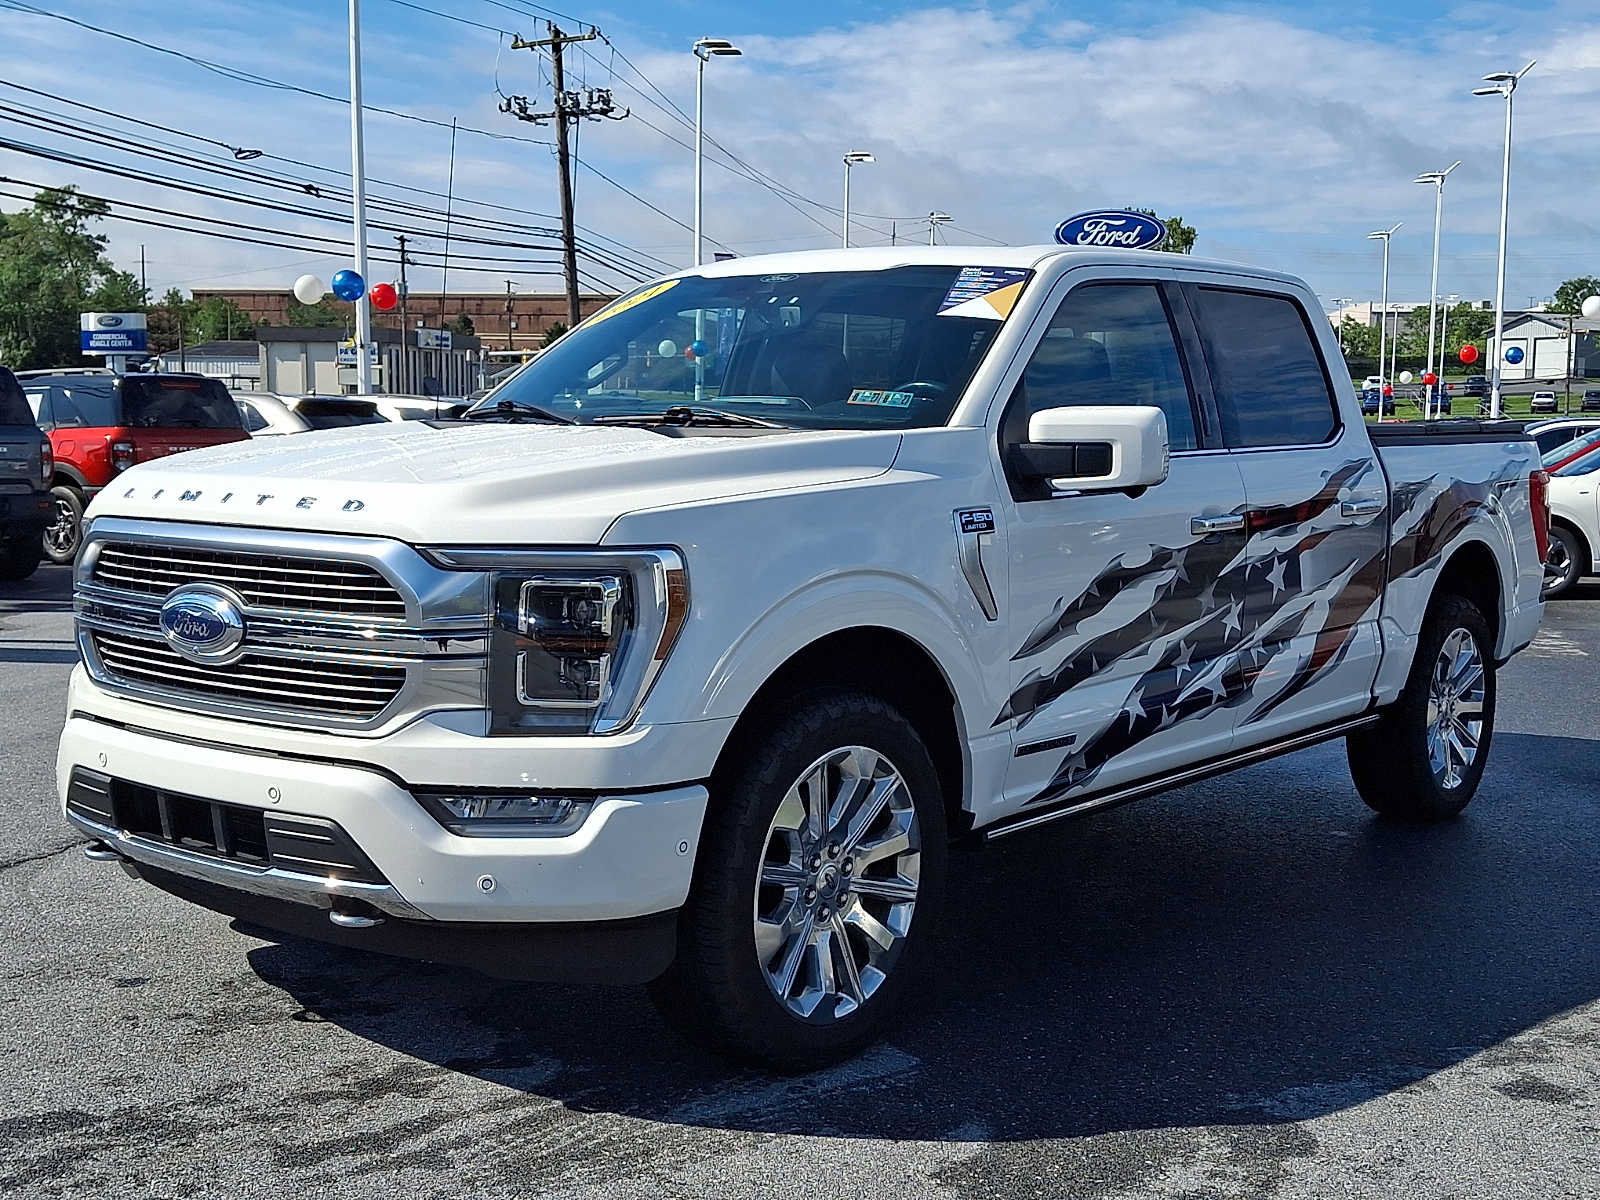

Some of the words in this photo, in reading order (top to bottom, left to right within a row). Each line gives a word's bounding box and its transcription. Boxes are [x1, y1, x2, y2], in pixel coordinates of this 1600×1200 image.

[1077, 218, 1143, 245] Ford
[123, 487, 366, 512] LIMITED
[962, 512, 993, 523] F-150
[173, 607, 211, 637] Ford
